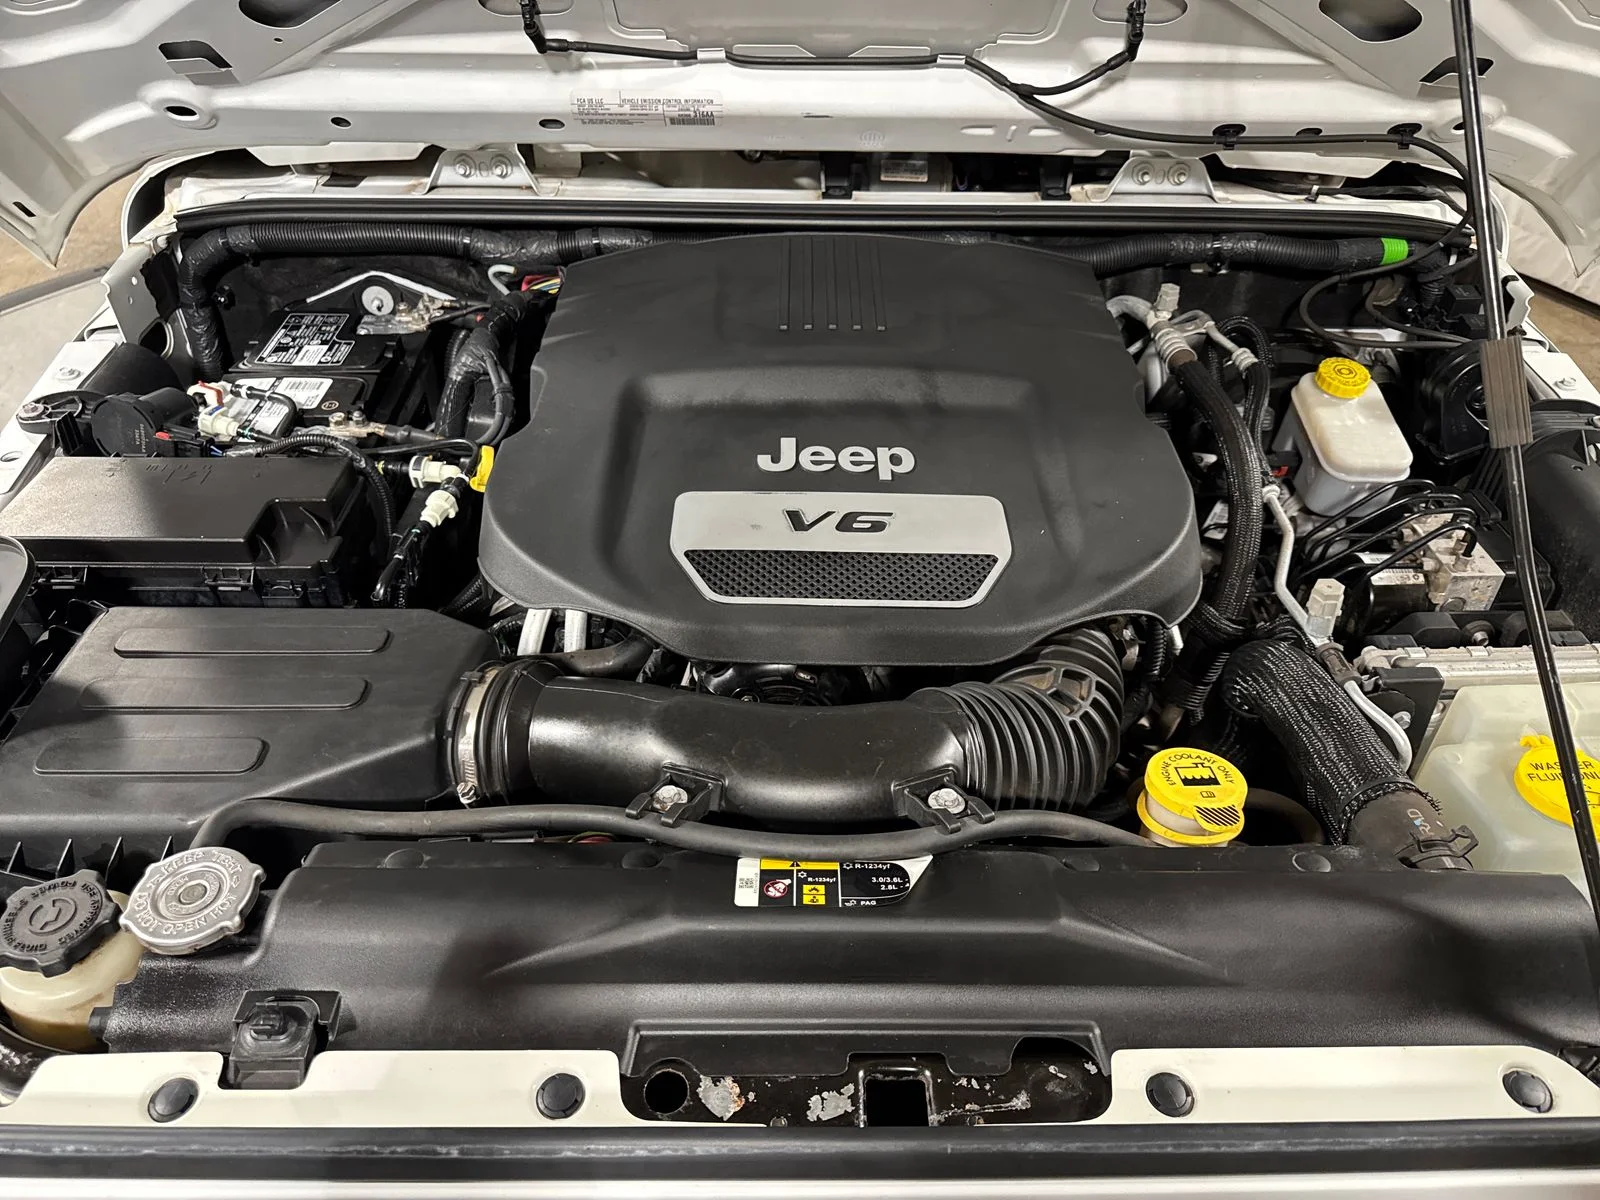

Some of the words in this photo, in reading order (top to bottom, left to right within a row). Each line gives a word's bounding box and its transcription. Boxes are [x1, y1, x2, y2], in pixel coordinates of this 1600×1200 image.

[757, 437, 916, 481] Jeep
[783, 509, 894, 533] V6
[1168, 753, 1217, 765] COOLANT
[1530, 760, 1594, 770] WASER
[1161, 761, 1176, 786] ENGINE
[1217, 765, 1236, 785] ONLY
[161, 851, 205, 874] KEEP
[212, 850, 243, 874] TIGHT
[134, 892, 148, 911] DO
[209, 893, 237, 920] HOT
[136, 910, 162, 932] NOT
[162, 916, 208, 936] OPEN
